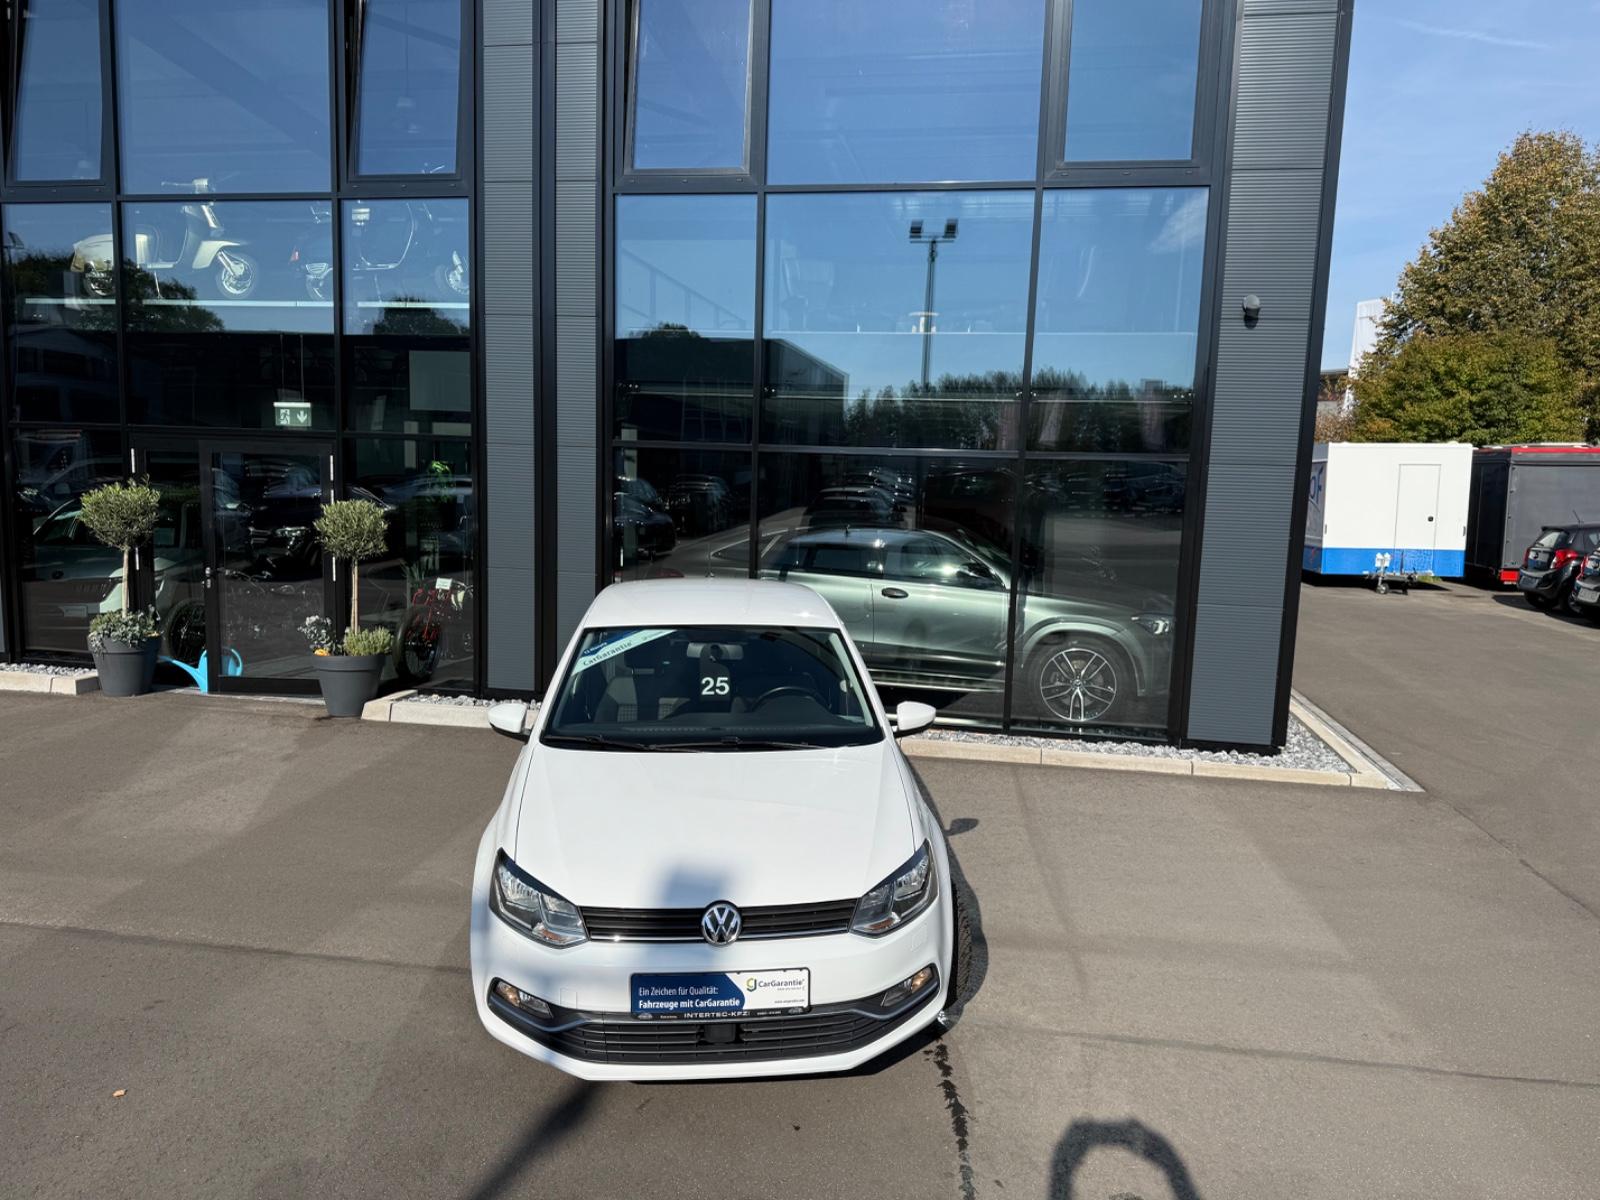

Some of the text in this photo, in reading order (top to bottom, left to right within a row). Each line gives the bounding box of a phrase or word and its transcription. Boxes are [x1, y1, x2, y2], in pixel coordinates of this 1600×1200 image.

[701, 677, 730, 695] 25
[639, 986, 718, 996] Ein Zeichen für Qualität:
[639, 998, 740, 1010] Fahrzeuge mit CarGarantie
